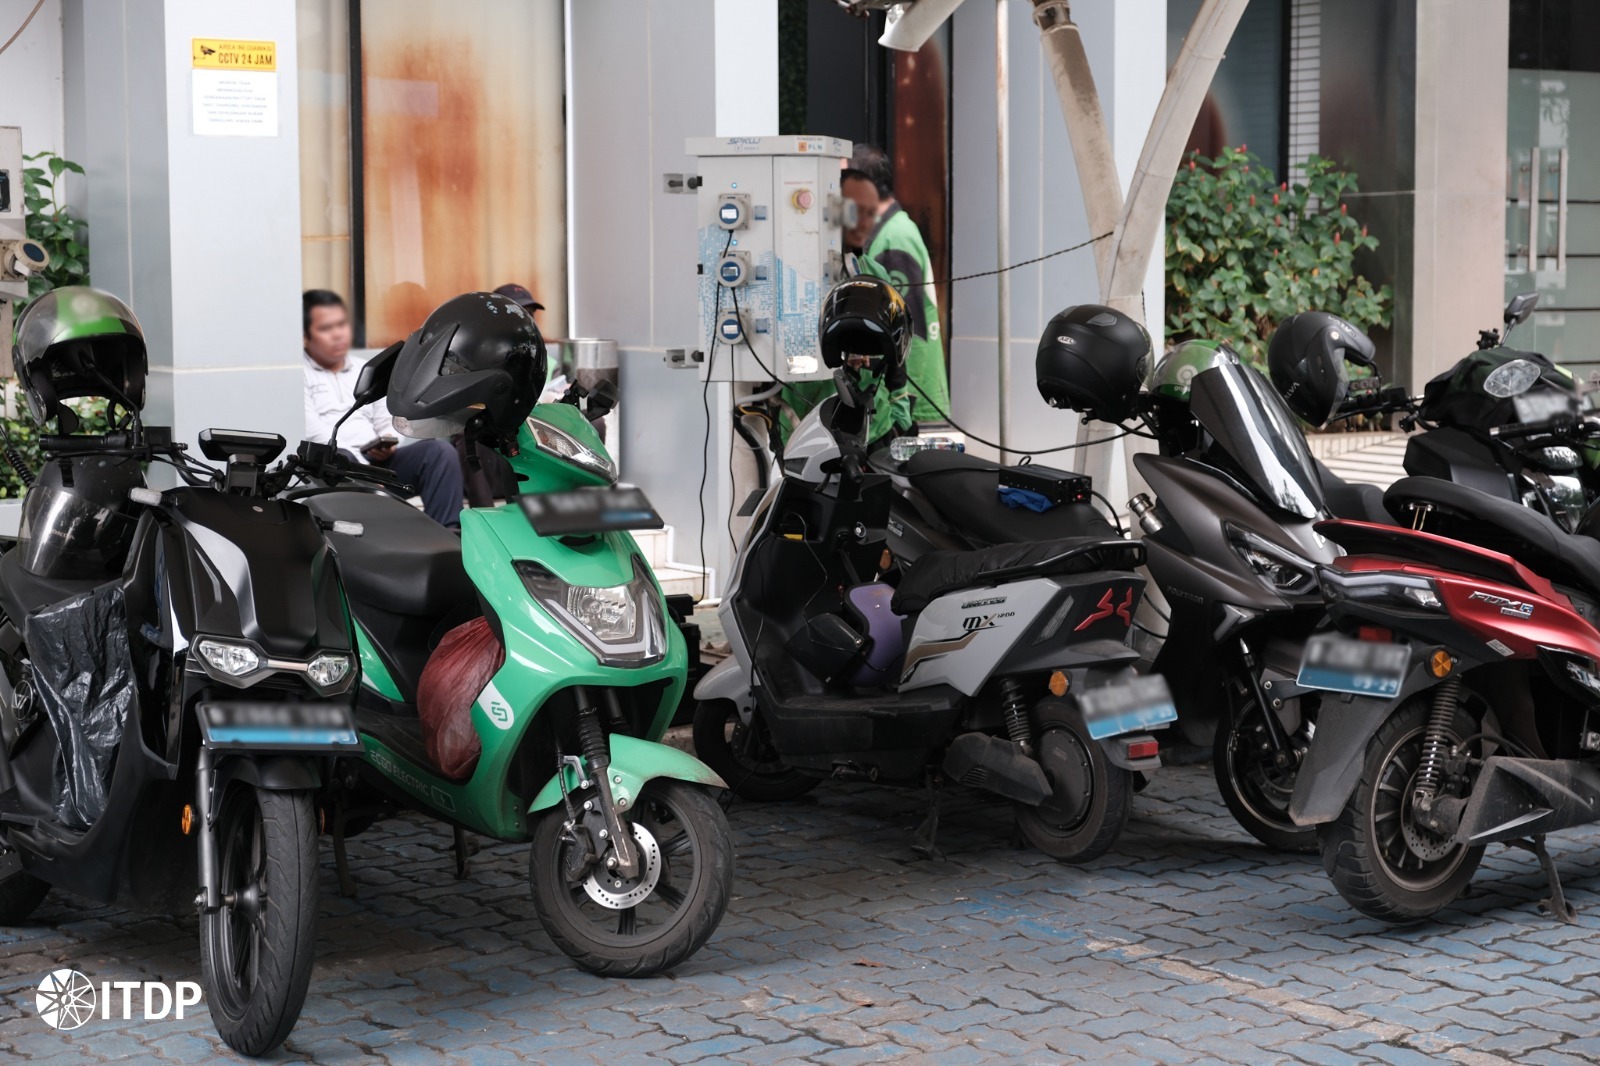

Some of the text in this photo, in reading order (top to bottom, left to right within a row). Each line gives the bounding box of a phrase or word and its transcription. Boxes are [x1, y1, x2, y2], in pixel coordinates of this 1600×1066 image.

[218, 53, 273, 65] CCTV 24 JAM
[392, 764, 430, 796] ELECTRIC
